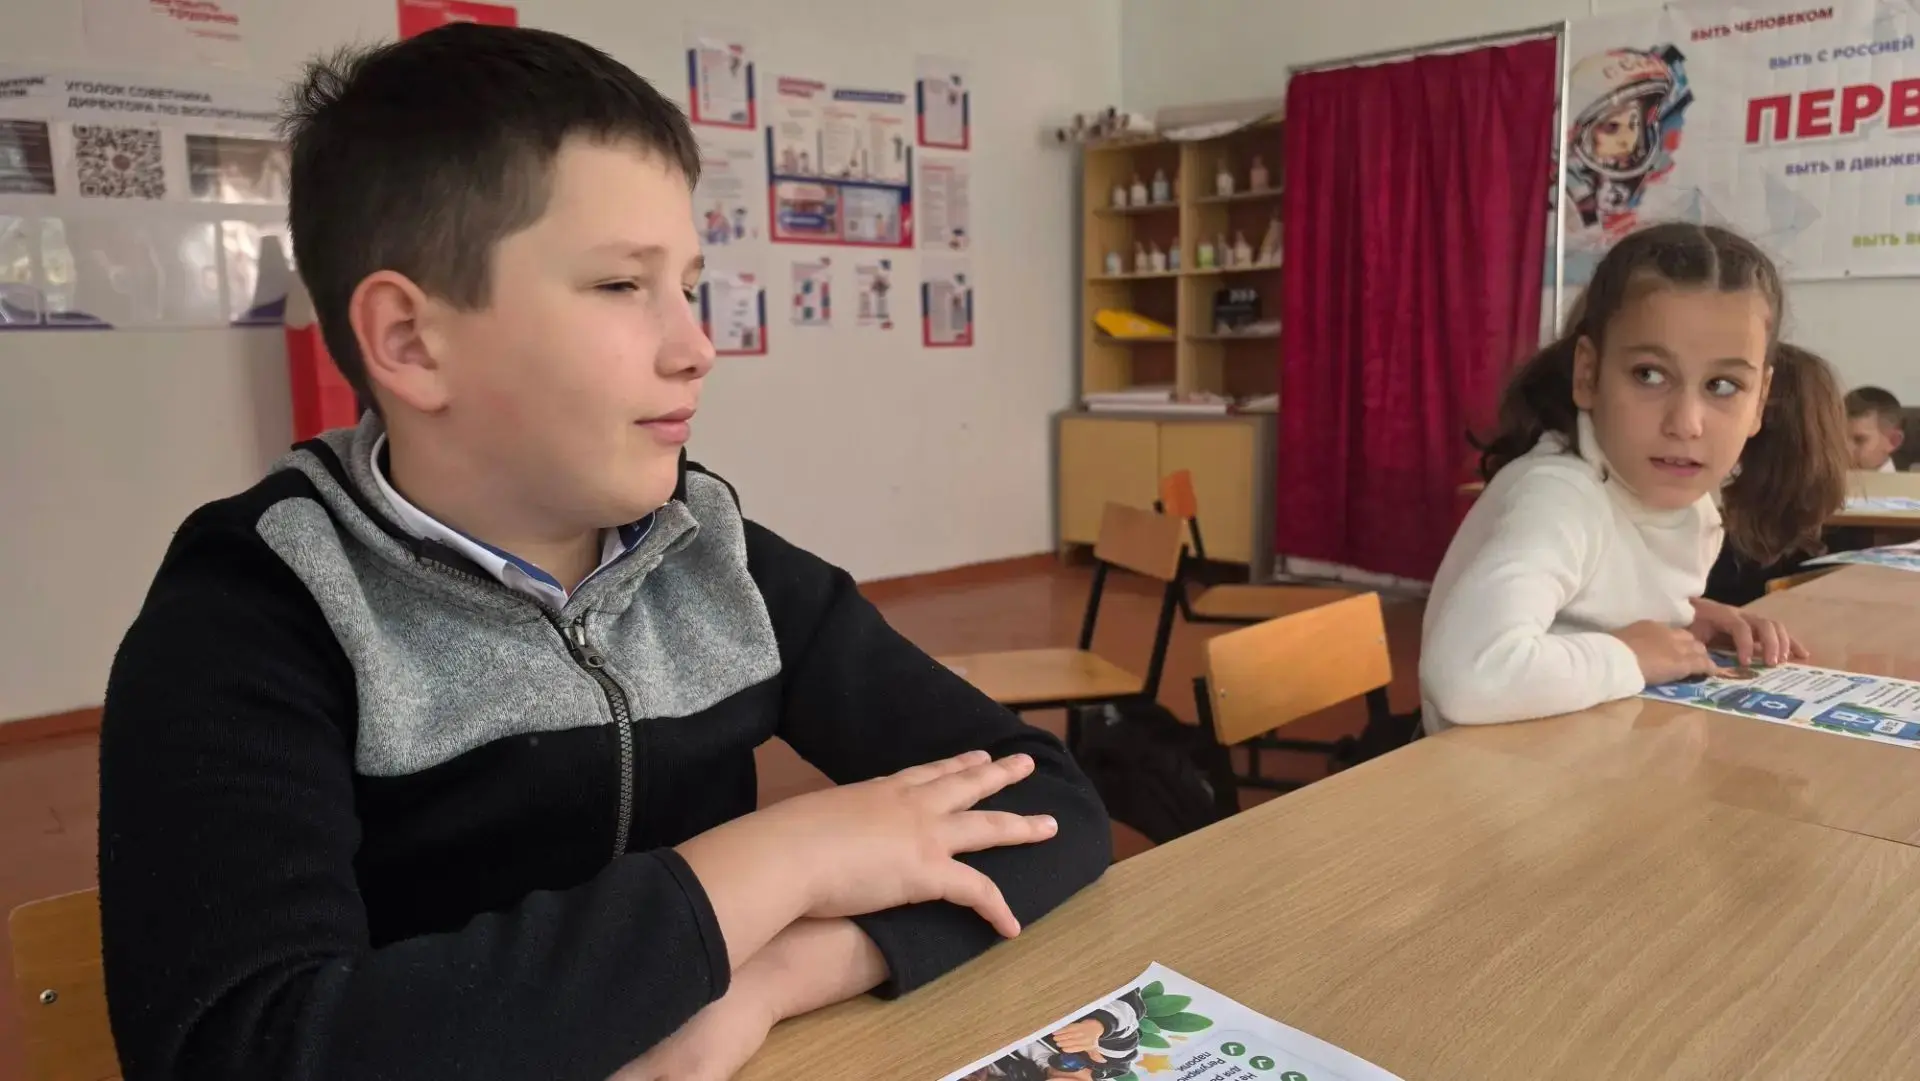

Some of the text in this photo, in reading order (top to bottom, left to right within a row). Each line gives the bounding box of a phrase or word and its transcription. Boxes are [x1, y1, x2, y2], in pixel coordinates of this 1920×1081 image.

[1691, 7, 1834, 41] БЫТЬ ЧЕЛОВЕКОМ
[1769, 34, 1914, 70] БЫТЬ С РОССИЕЙ
[65, 80, 212, 102] УГОЛОК СОВЕТНИКА
[68, 96, 153, 113] ДИРЕКТОРА
[157, 103, 178, 115] ПО
[1785, 160, 1831, 175] БЫТЬ
[1835, 159, 1845, 171] В
[1852, 233, 1899, 248] БЫТЬ
[1222, 1065, 1242, 1079] для
